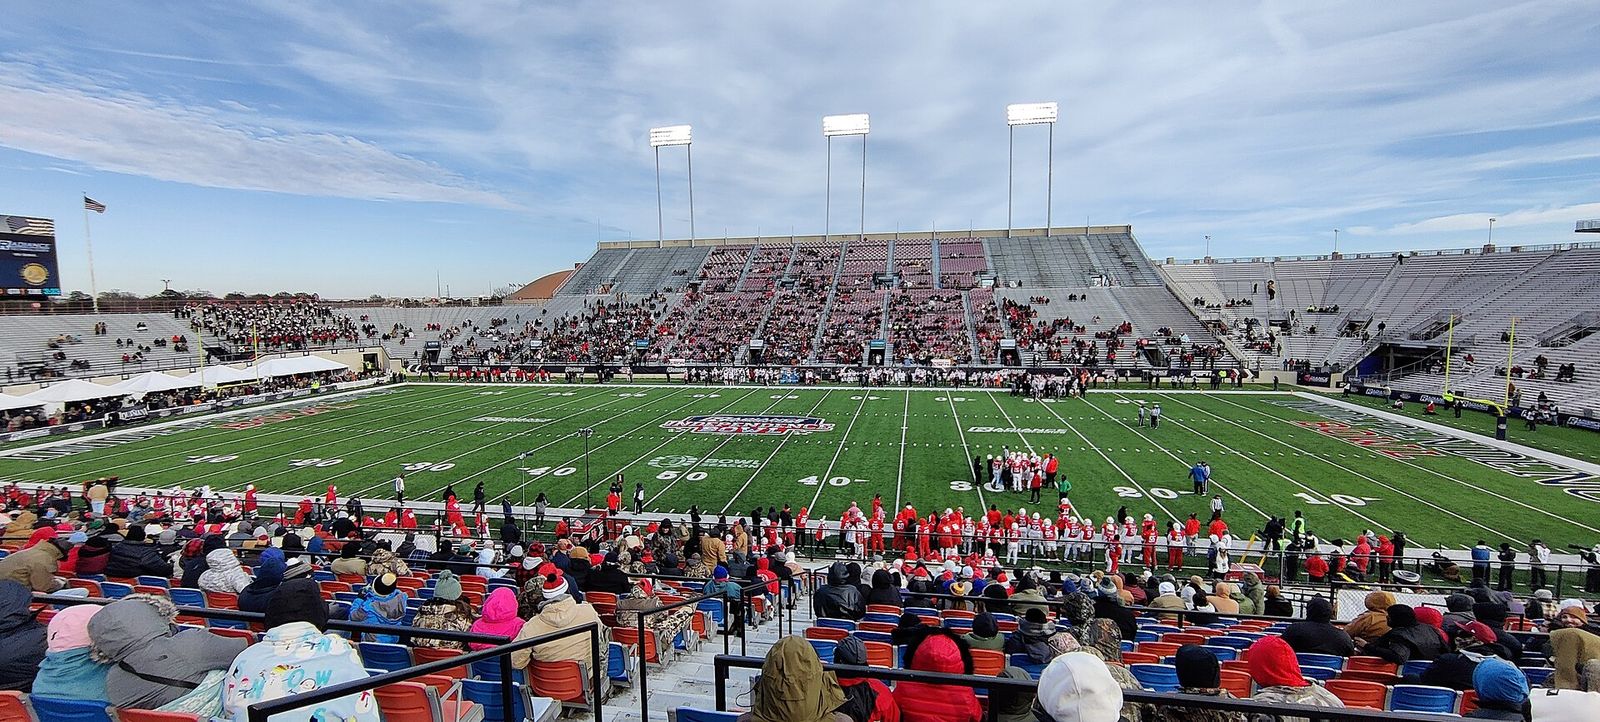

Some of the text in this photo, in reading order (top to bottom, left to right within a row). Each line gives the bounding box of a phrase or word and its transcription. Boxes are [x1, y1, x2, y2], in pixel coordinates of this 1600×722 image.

[526, 466, 577, 477] 40
[656, 470, 708, 481] 50
[798, 475, 850, 487] 40
[950, 480, 1004, 492] 30
[1113, 486, 1178, 499] 20
[1292, 492, 1368, 506] 10
